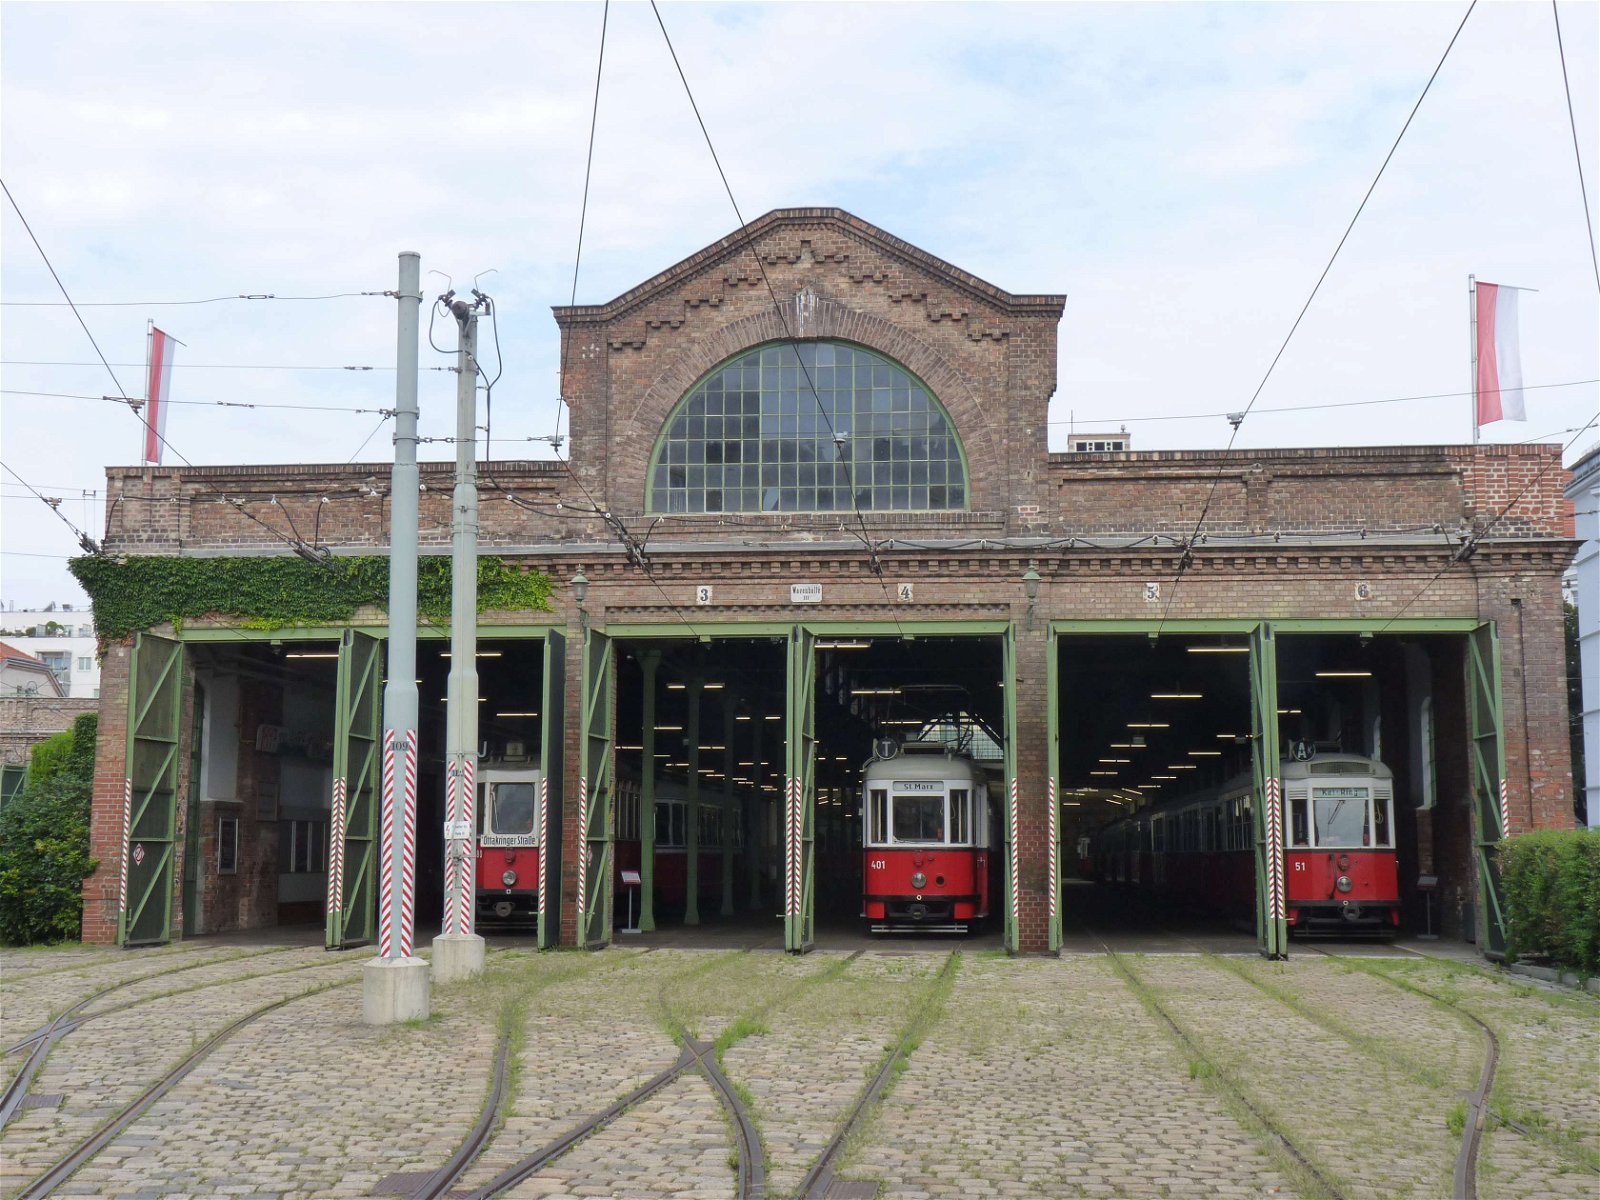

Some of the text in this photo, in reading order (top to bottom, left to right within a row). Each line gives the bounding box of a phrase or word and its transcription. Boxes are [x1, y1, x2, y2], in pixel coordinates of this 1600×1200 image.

[700, 588, 709, 602] 3
[900, 585, 910, 600] 4
[1147, 586, 1156, 600] 5
[1357, 584, 1370, 599] 6
[391, 741, 409, 751] 109
[881, 741, 892, 757] T
[483, 835, 517, 846] Ottakringer
[871, 860, 886, 870] 401
[1295, 861, 1306, 871] 51
